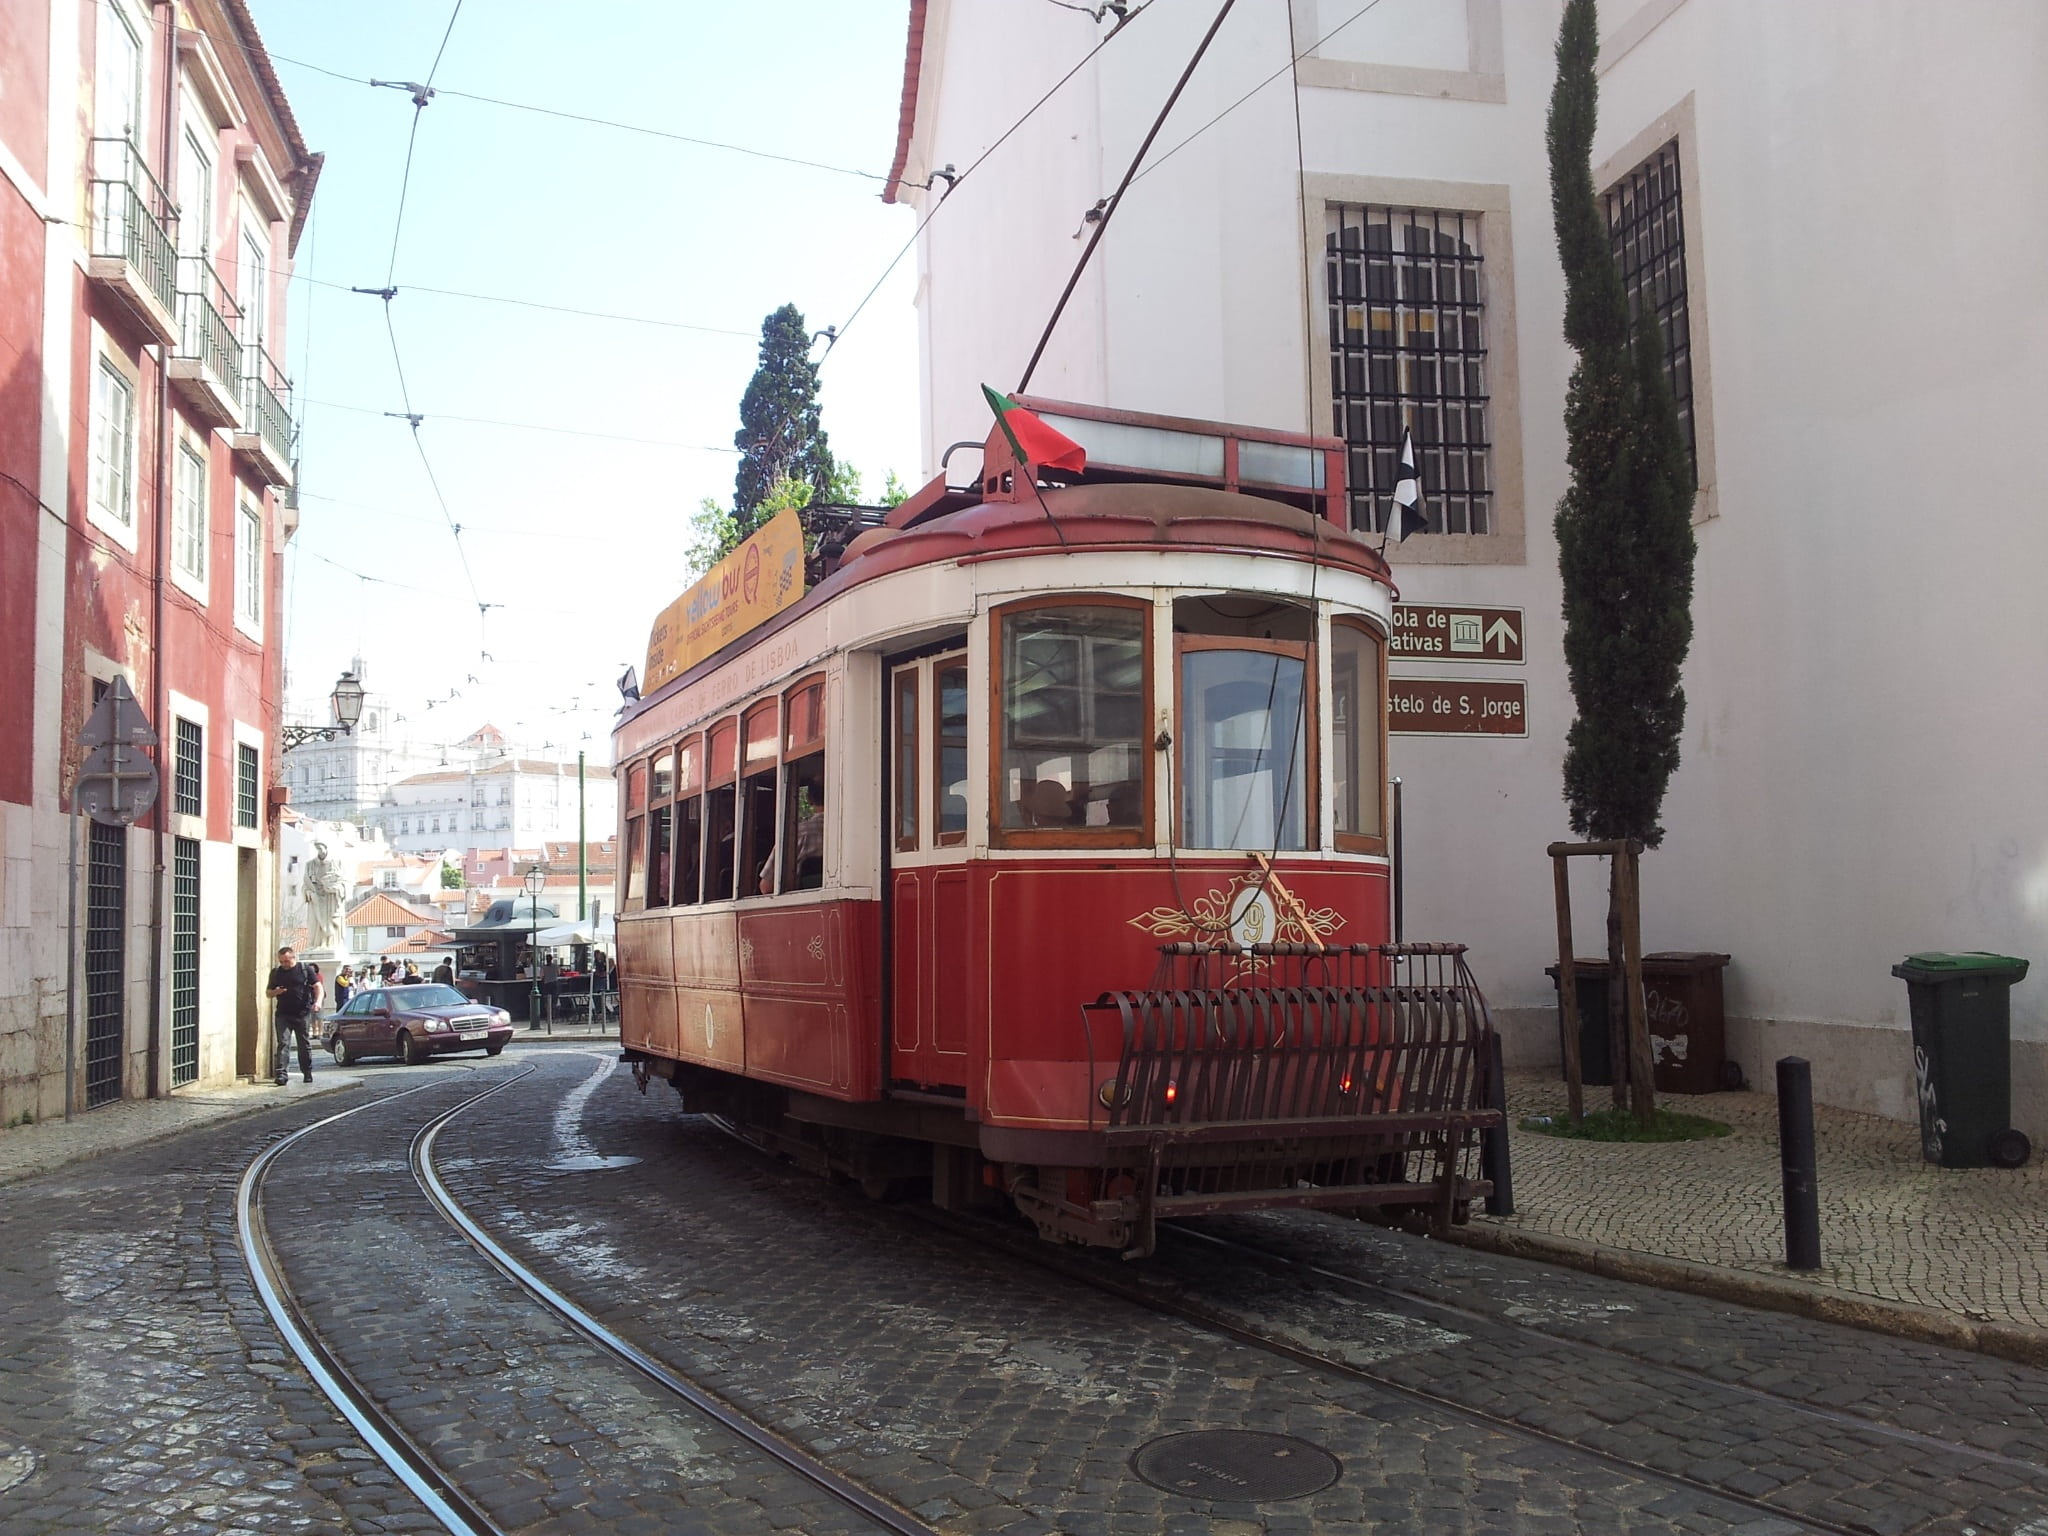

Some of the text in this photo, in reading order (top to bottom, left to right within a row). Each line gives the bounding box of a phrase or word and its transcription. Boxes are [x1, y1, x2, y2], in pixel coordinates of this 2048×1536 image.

[1393, 607, 1447, 628] ola de
[1392, 632, 1443, 651] ativas
[745, 661, 756, 682] DE
[760, 638, 799, 676] LISBOA
[1387, 694, 1521, 719] stelo de S. Jorge
[1243, 902, 1265, 943] 9
